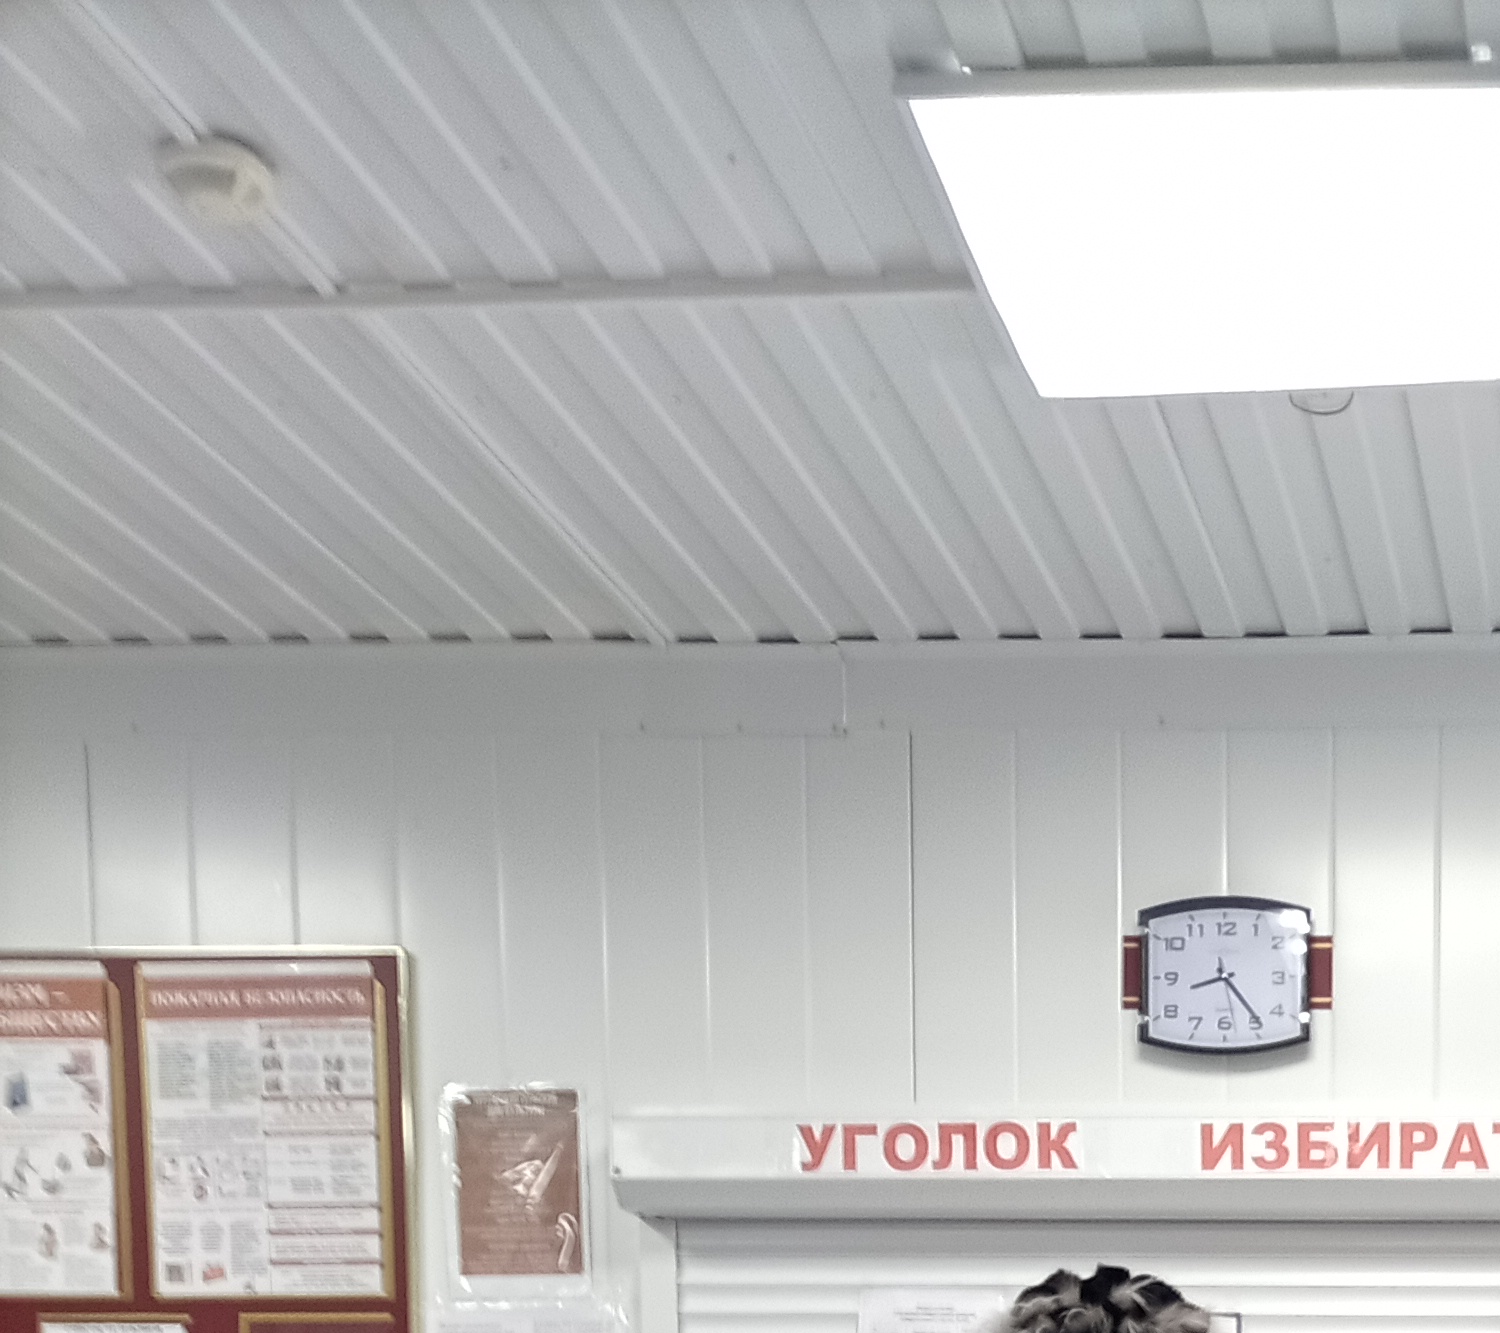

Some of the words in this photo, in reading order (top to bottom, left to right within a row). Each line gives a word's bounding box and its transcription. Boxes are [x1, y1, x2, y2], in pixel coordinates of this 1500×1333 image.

[1186, 923, 1205, 937] 11
[1215, 922, 1237, 936] 12
[1252, 923, 1260, 937] 1
[1163, 936, 1186, 951] 10
[1271, 936, 1285, 950] 2
[1163, 971, 1179, 986] 9
[1271, 971, 1286, 985] 3
[1163, 1004, 1179, 1019] 8
[1269, 1003, 1285, 1017] 4
[1187, 1016, 1203, 1031] 7
[1216, 1016, 1233, 1031] 6
[796, 1121, 1079, 1172] УГОЛОК
